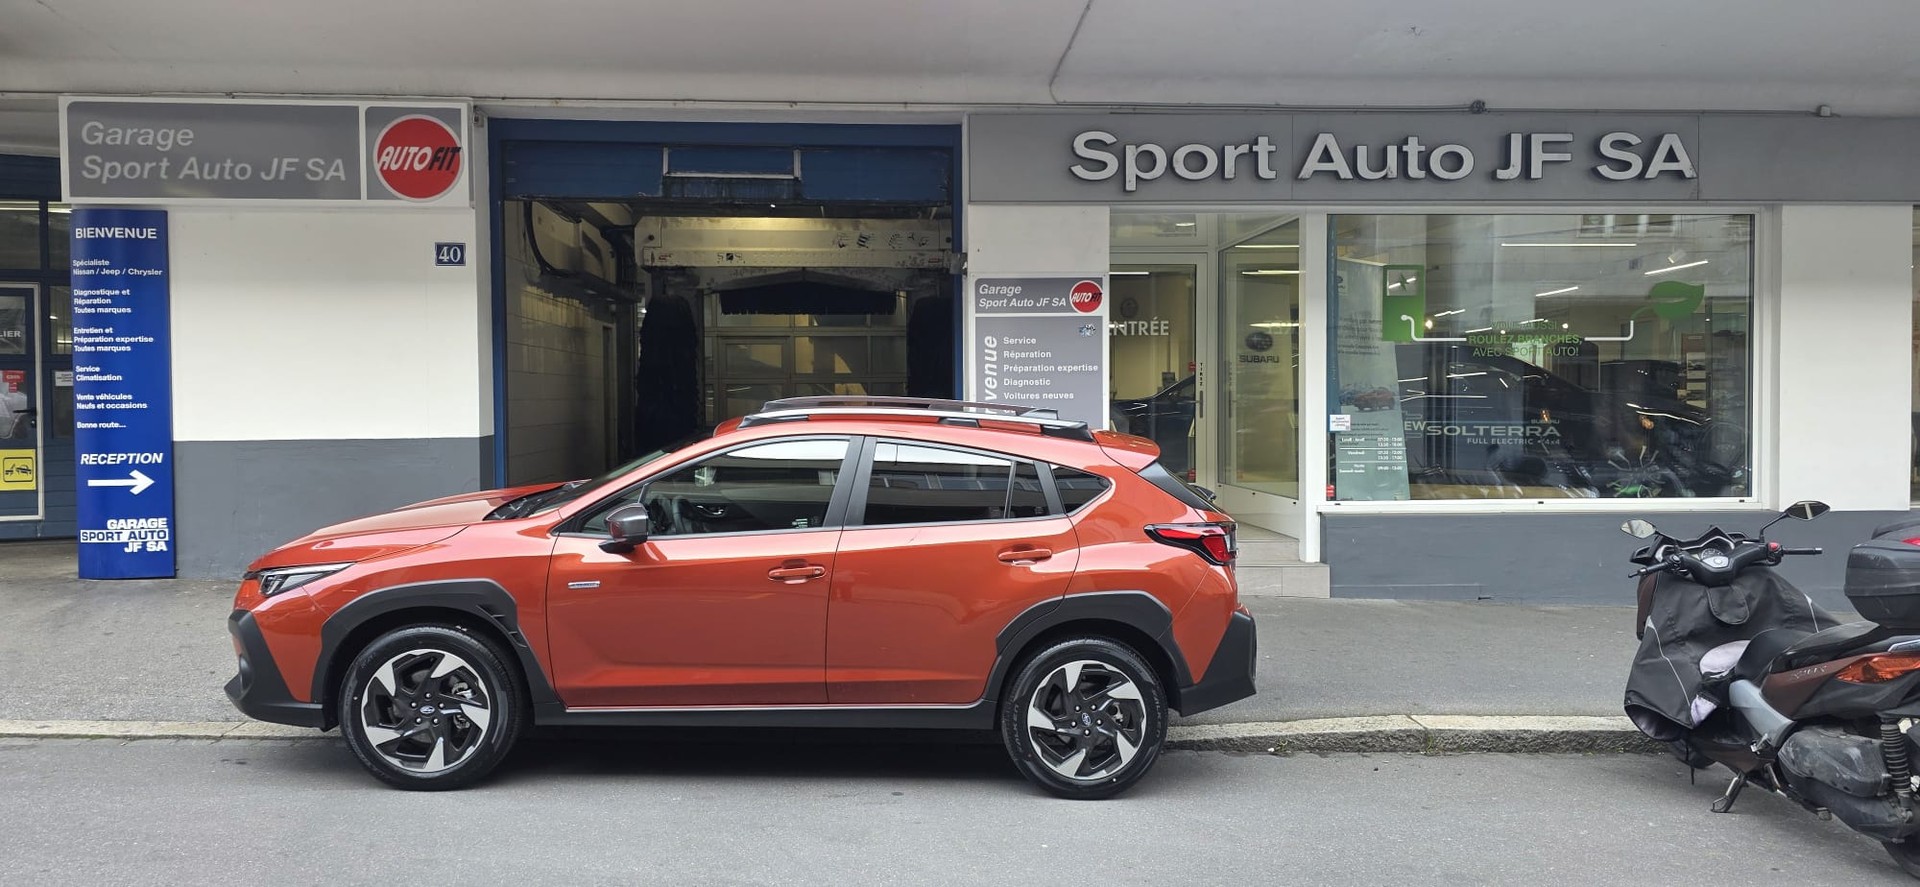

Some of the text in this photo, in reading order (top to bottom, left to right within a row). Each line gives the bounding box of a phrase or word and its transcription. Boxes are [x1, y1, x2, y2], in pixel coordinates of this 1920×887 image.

[81, 121, 194, 151] Garage
[379, 146, 462, 171] AUTOFIT
[1069, 130, 1698, 192] Sport Auto JF SA
[81, 155, 347, 184] Sport Auto JF SA
[75, 227, 157, 239] BIENVENUE
[438, 246, 461, 262] 40
[72, 259, 110, 267] Spécialiste
[72, 268, 95, 276] Nissan
[100, 268, 121, 276] Jeep
[127, 268, 163, 277] Chrysler
[73, 288, 131, 297] Diagnostique et
[979, 284, 1022, 297] Garage
[978, 297, 1067, 309] Sport Auto JF SA
[73, 336, 154, 344] Préparation expertise
[1003, 336, 1037, 345] Service
[1468, 334, 1513, 345] ROULEZ
[1003, 350, 1052, 360] Réparation
[1472, 346, 1580, 357] AVEC SPORT AUTO!
[1238, 354, 1280, 364] SUBARU
[75, 365, 101, 373] Service
[1003, 364, 1099, 373] Préparation expertise
[76, 374, 122, 382] Climatisation
[1003, 378, 1051, 388] Diagnostic
[1003, 391, 1040, 400] Voitures
[1403, 421, 1426, 431] EW
[1426, 425, 1561, 436] SOLTERRA
[80, 452, 163, 465] RECEPTION
[106, 518, 167, 530] GARAGE
[81, 530, 167, 541] SPORT AUTO
[124, 541, 167, 552] JF SA
